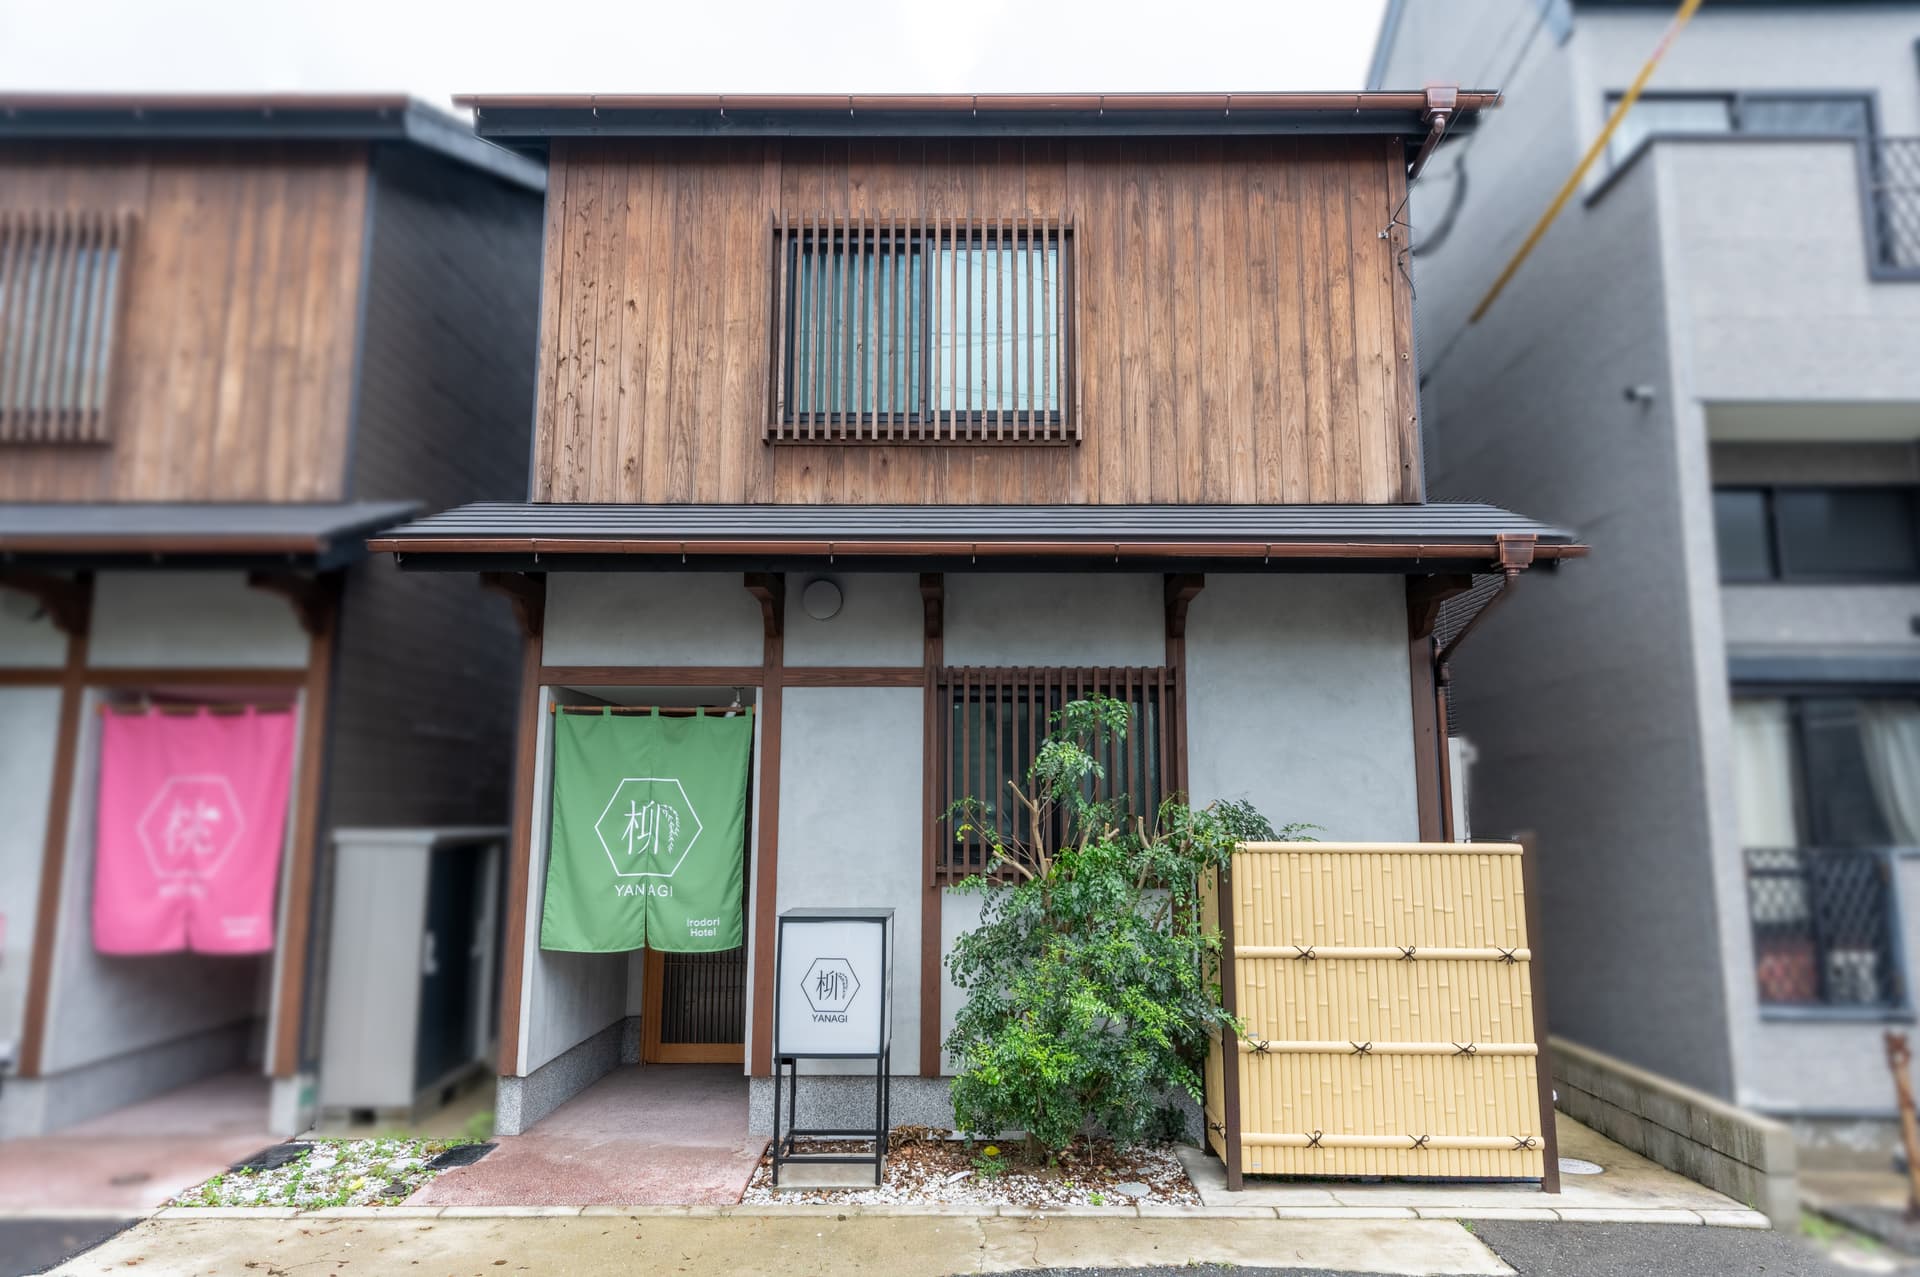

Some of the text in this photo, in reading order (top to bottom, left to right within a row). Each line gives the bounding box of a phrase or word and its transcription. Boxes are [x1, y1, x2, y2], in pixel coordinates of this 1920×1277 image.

[620, 800, 681, 855] 柳
[615, 884, 673, 897] YANAGI
[687, 917, 720, 927] Irodori
[690, 928, 717, 937] Hotel
[815, 969, 848, 1001] 柳
[812, 1014, 848, 1023] YANAGI
